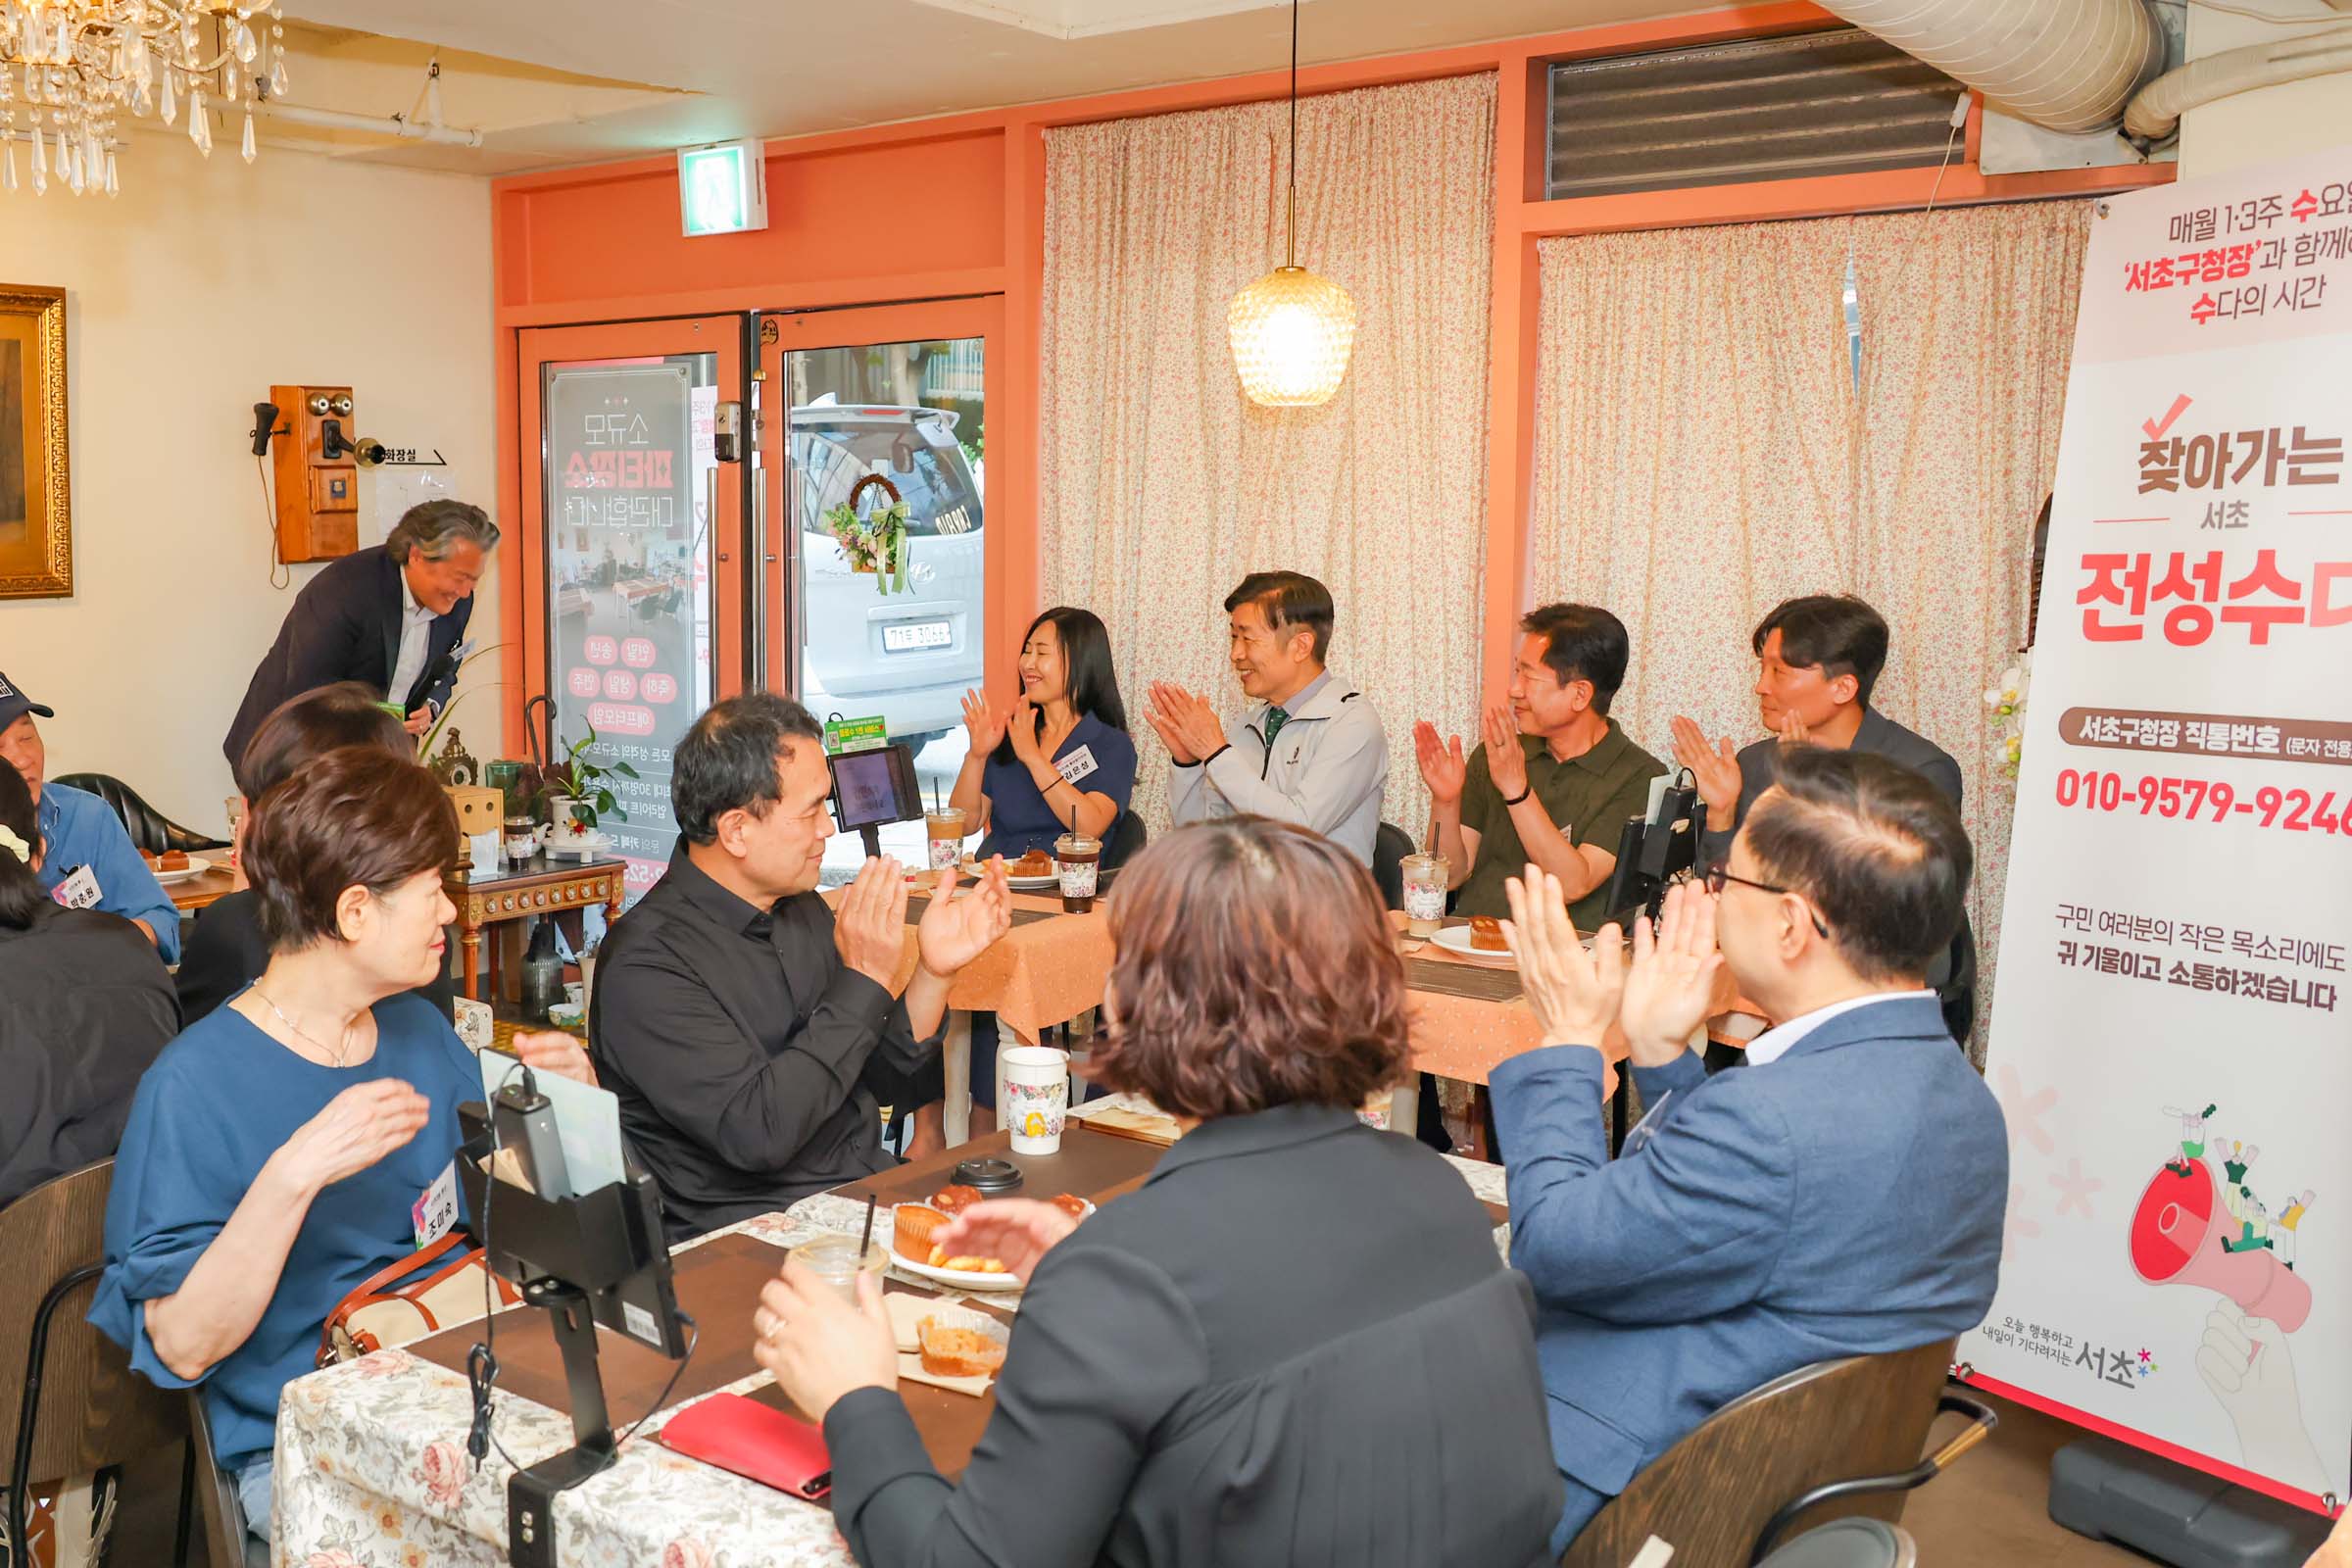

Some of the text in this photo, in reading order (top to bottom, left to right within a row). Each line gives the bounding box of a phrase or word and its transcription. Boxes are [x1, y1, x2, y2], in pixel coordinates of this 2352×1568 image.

[2169, 207, 2217, 244] 매월
[2290, 180, 2352, 223] 수요
[2294, 225, 2352, 268] 함께
[2190, 273, 2327, 325] 수다의 시간
[384, 448, 416, 463] 화장실
[2137, 425, 2344, 495] 찾아가는
[2200, 499, 2250, 531] 서초
[2079, 715, 2180, 748] 서초구청장
[2184, 720, 2280, 755] 직통번호
[2286, 737, 2321, 757] (문자
[2055, 904, 2345, 972] 구민 여러분의 작은 목소리에도
[2057, 941, 2337, 1011] 귀 기울이고 소통하겠습니다
[1983, 1325, 2072, 1367] 내일이 기다려지는
[2003, 1316, 2074, 1349] 오늘 행복하고
[2076, 1341, 2135, 1390] 서초
